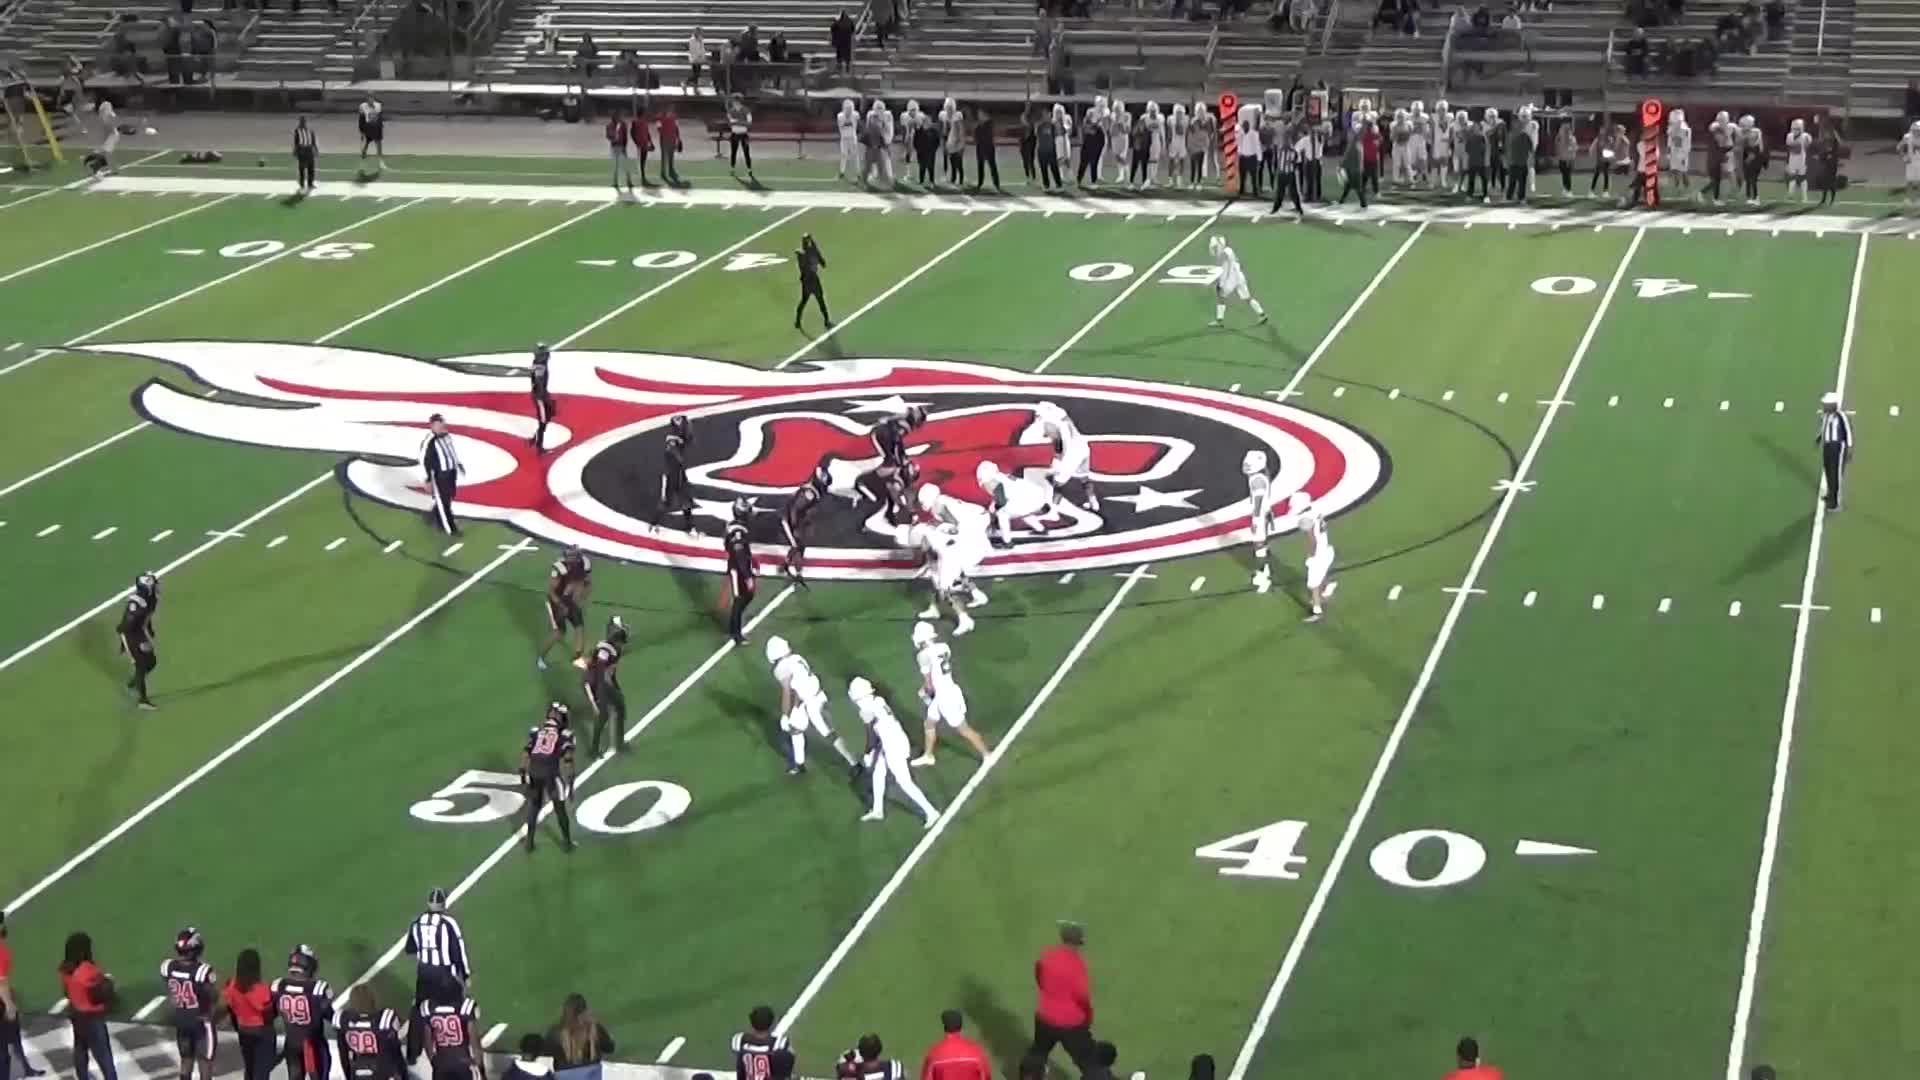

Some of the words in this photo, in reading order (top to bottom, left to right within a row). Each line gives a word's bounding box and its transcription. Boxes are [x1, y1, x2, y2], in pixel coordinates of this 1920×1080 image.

[409, 769, 692, 833] 50
[1195, 819, 1487, 887] 40
[430, 1014, 463, 1046] 29
